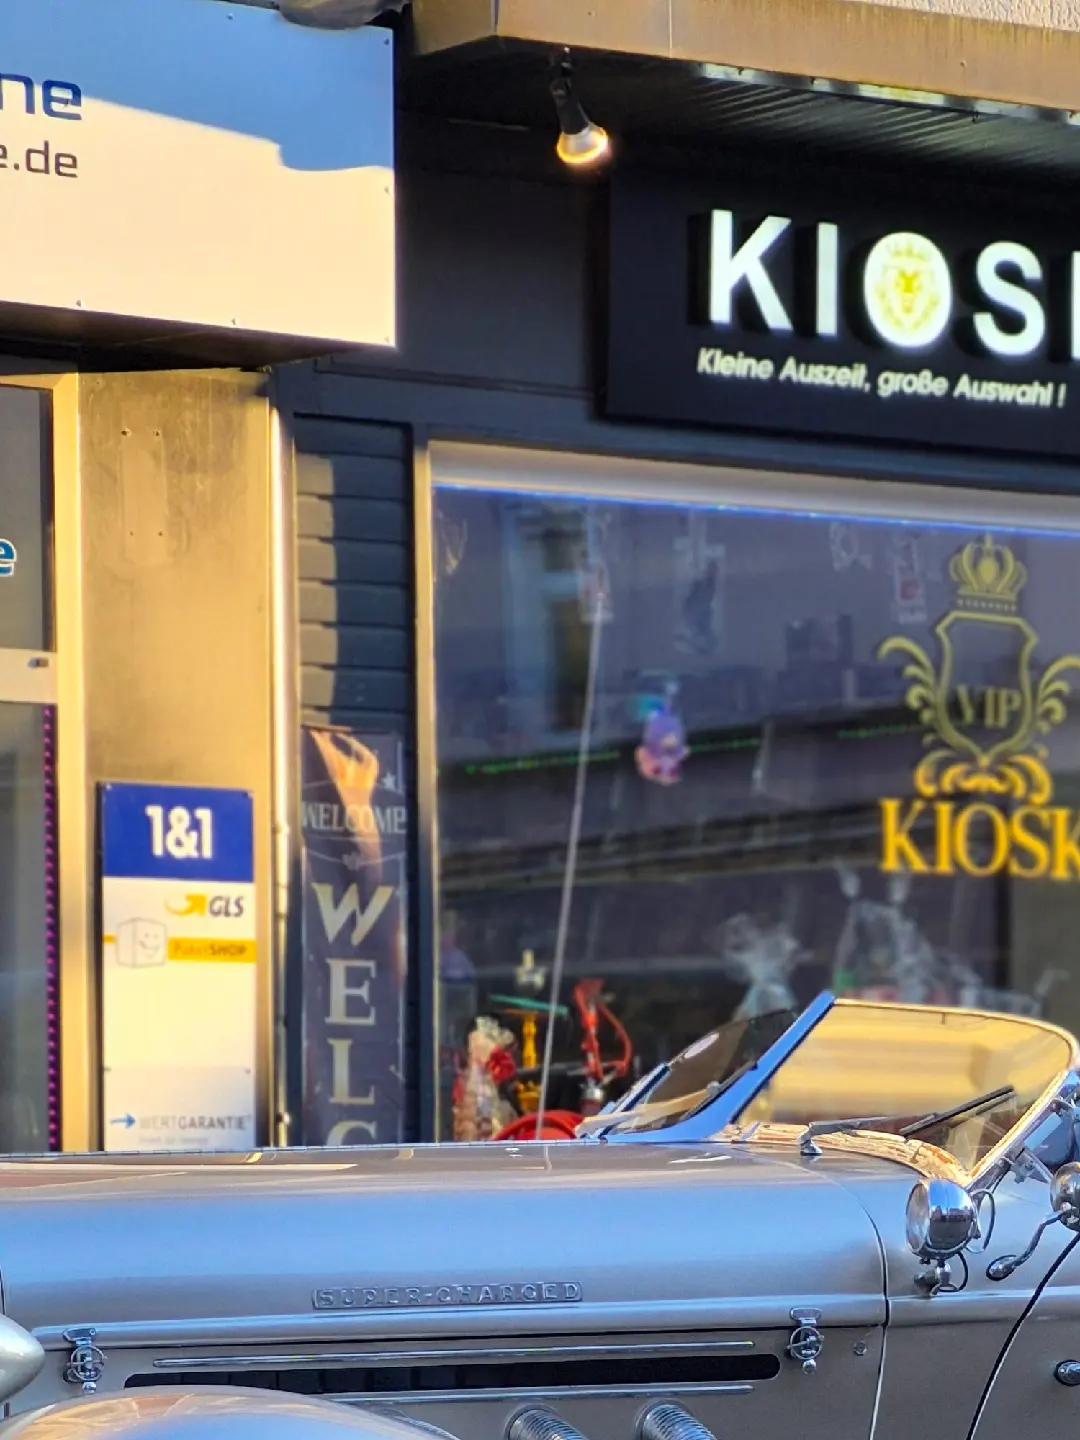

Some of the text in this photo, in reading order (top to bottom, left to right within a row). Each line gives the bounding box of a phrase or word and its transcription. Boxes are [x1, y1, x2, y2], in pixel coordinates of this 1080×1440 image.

[697, 347, 774, 379] Kleine
[779, 356, 871, 393] Auszeit,
[877, 368, 949, 398] große
[953, 374, 1053, 407] Auswahl
[956, 684, 1022, 729] VIP
[145, 804, 213, 859] 1&1
[208, 895, 245, 918] GLS
